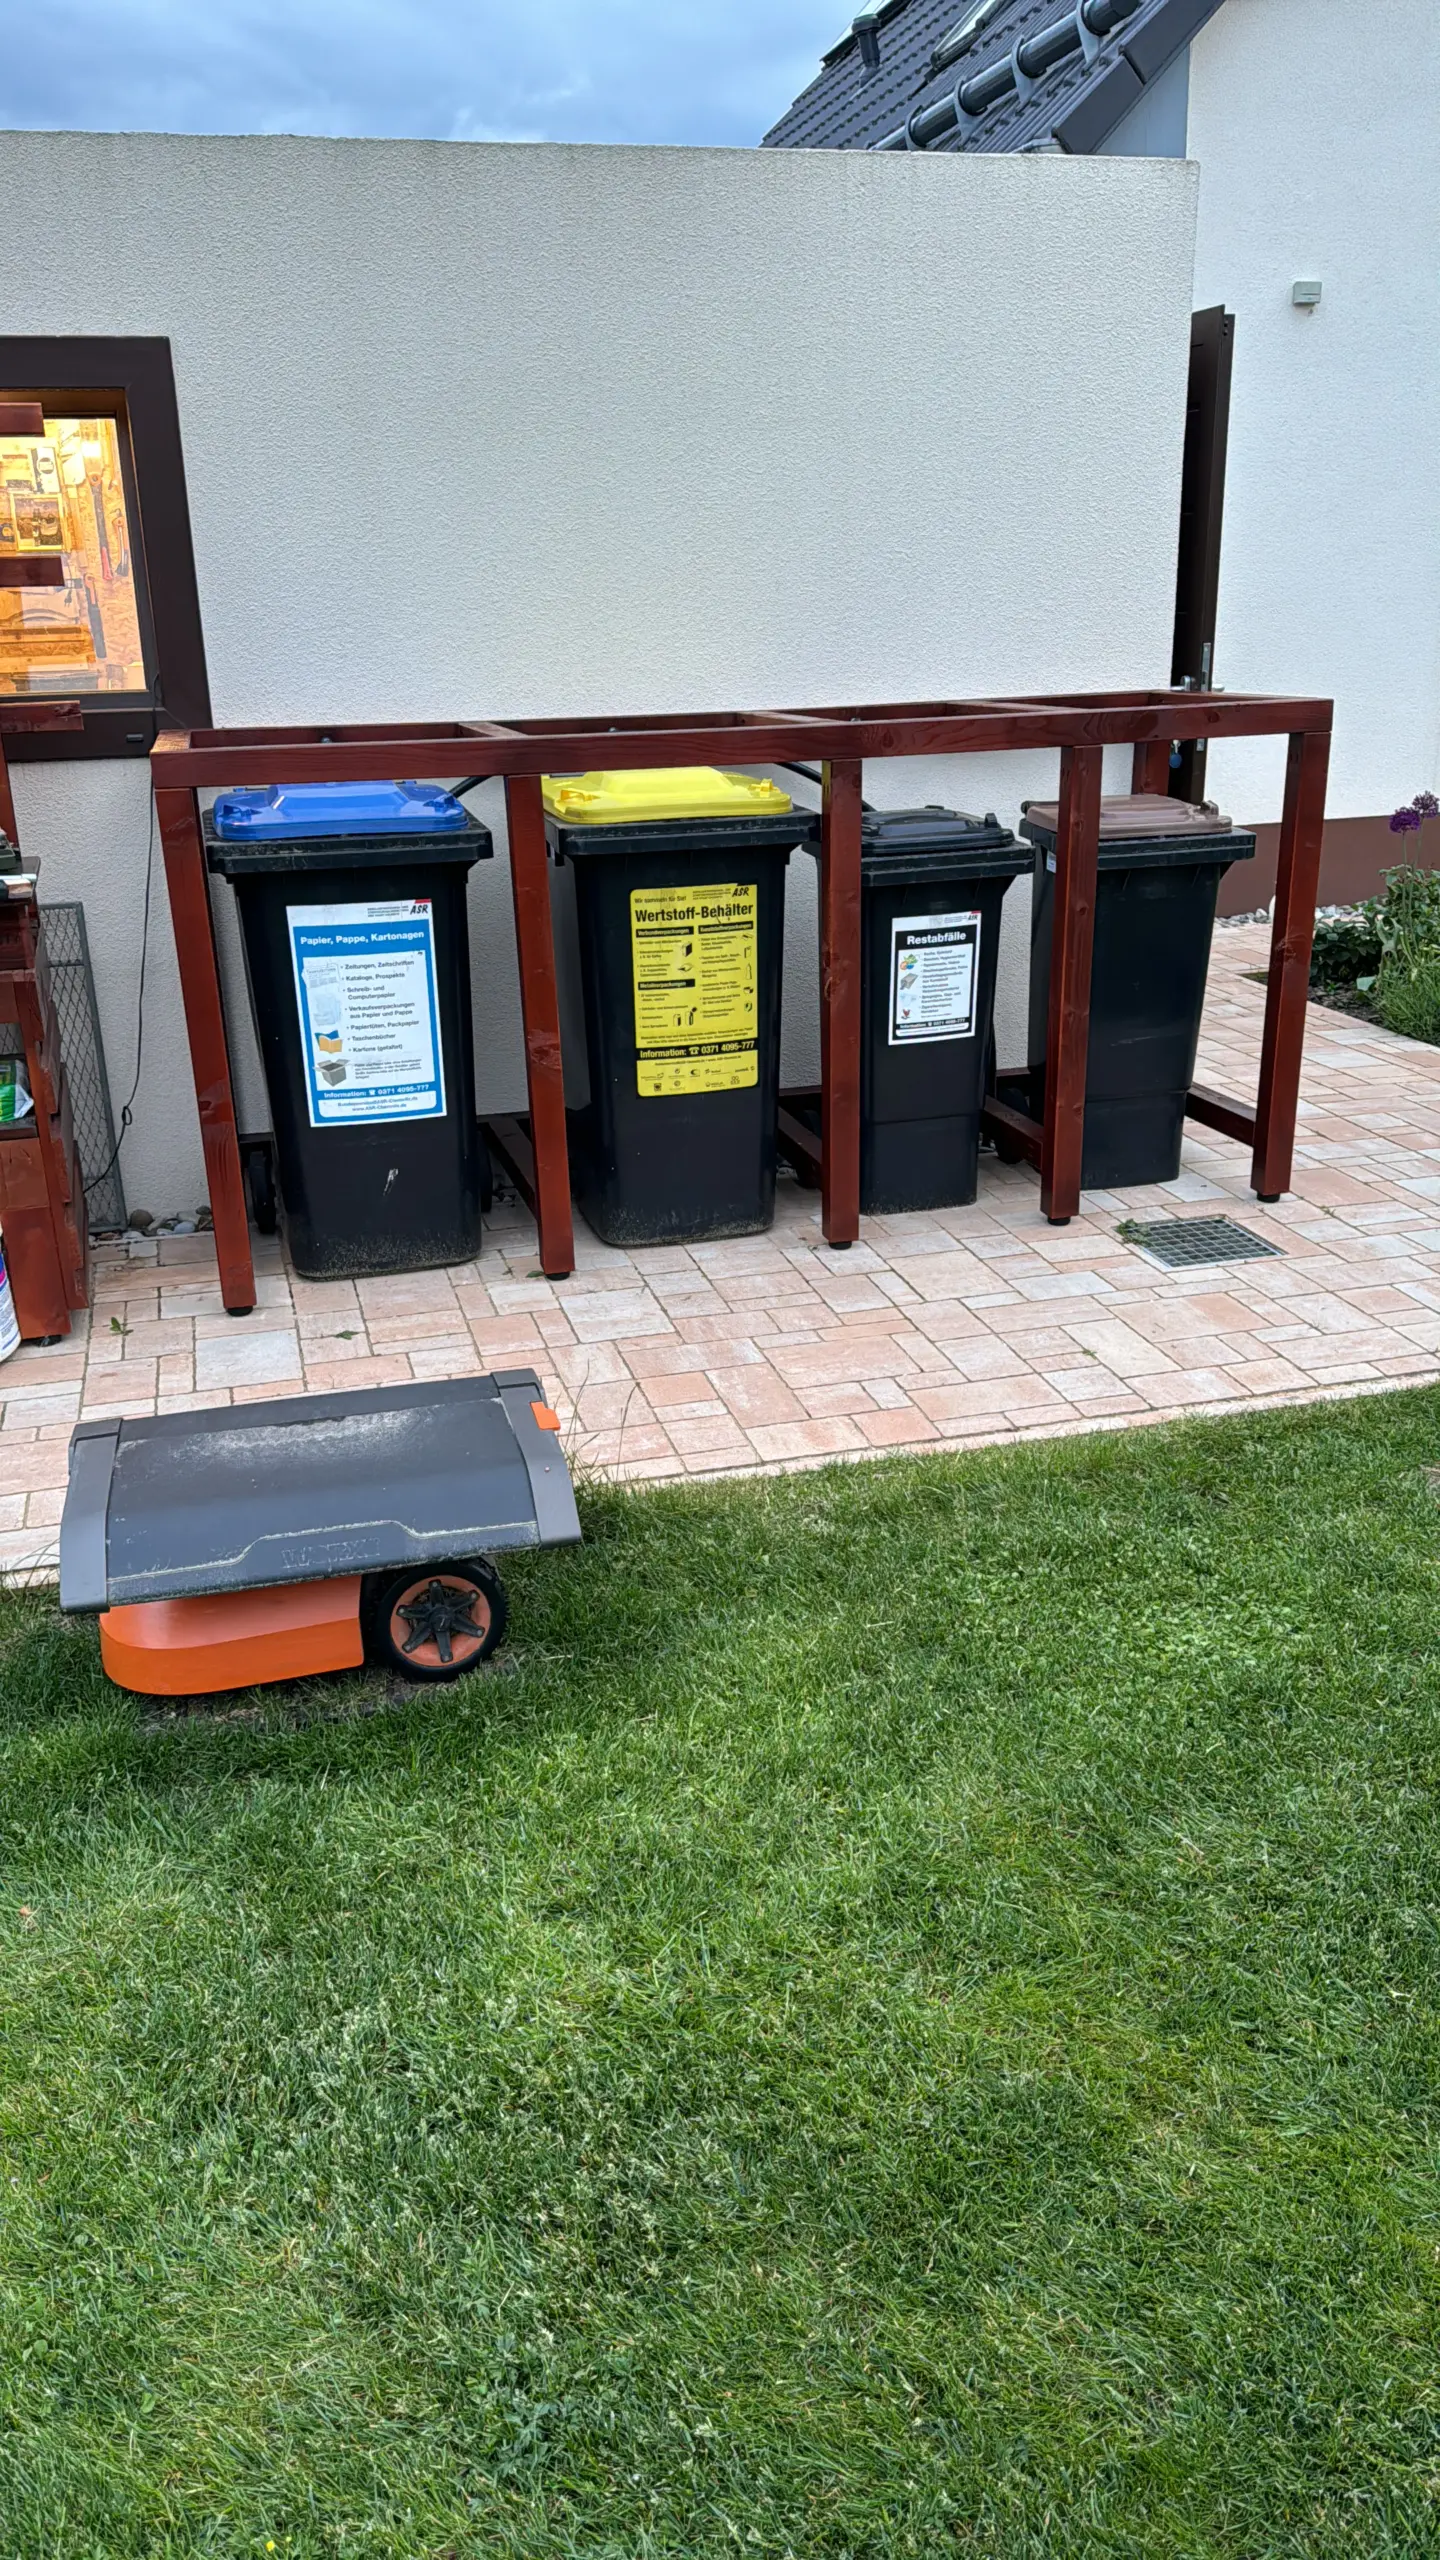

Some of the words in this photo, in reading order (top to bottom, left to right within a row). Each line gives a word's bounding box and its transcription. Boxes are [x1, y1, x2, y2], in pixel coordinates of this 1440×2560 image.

[732, 887, 749, 897] ASR
[410, 904, 428, 914] ASR
[635, 904, 754, 922] Wertstoff-Behälter
[300, 936, 333, 946] Papier,
[336, 934, 368, 944] Pappe,
[371, 931, 424, 942] Kartonagen
[906, 931, 967, 945] Restabfälle
[348, 992, 395, 1000] Computerpapier
[349, 1002, 415, 1012] Verkaufsverpackungen
[640, 1050, 687, 1059] Information:
[701, 1045, 719, 1054] 0371
[722, 1040, 754, 1052] 4095-777
[397, 1084, 429, 1093] 4095-777
